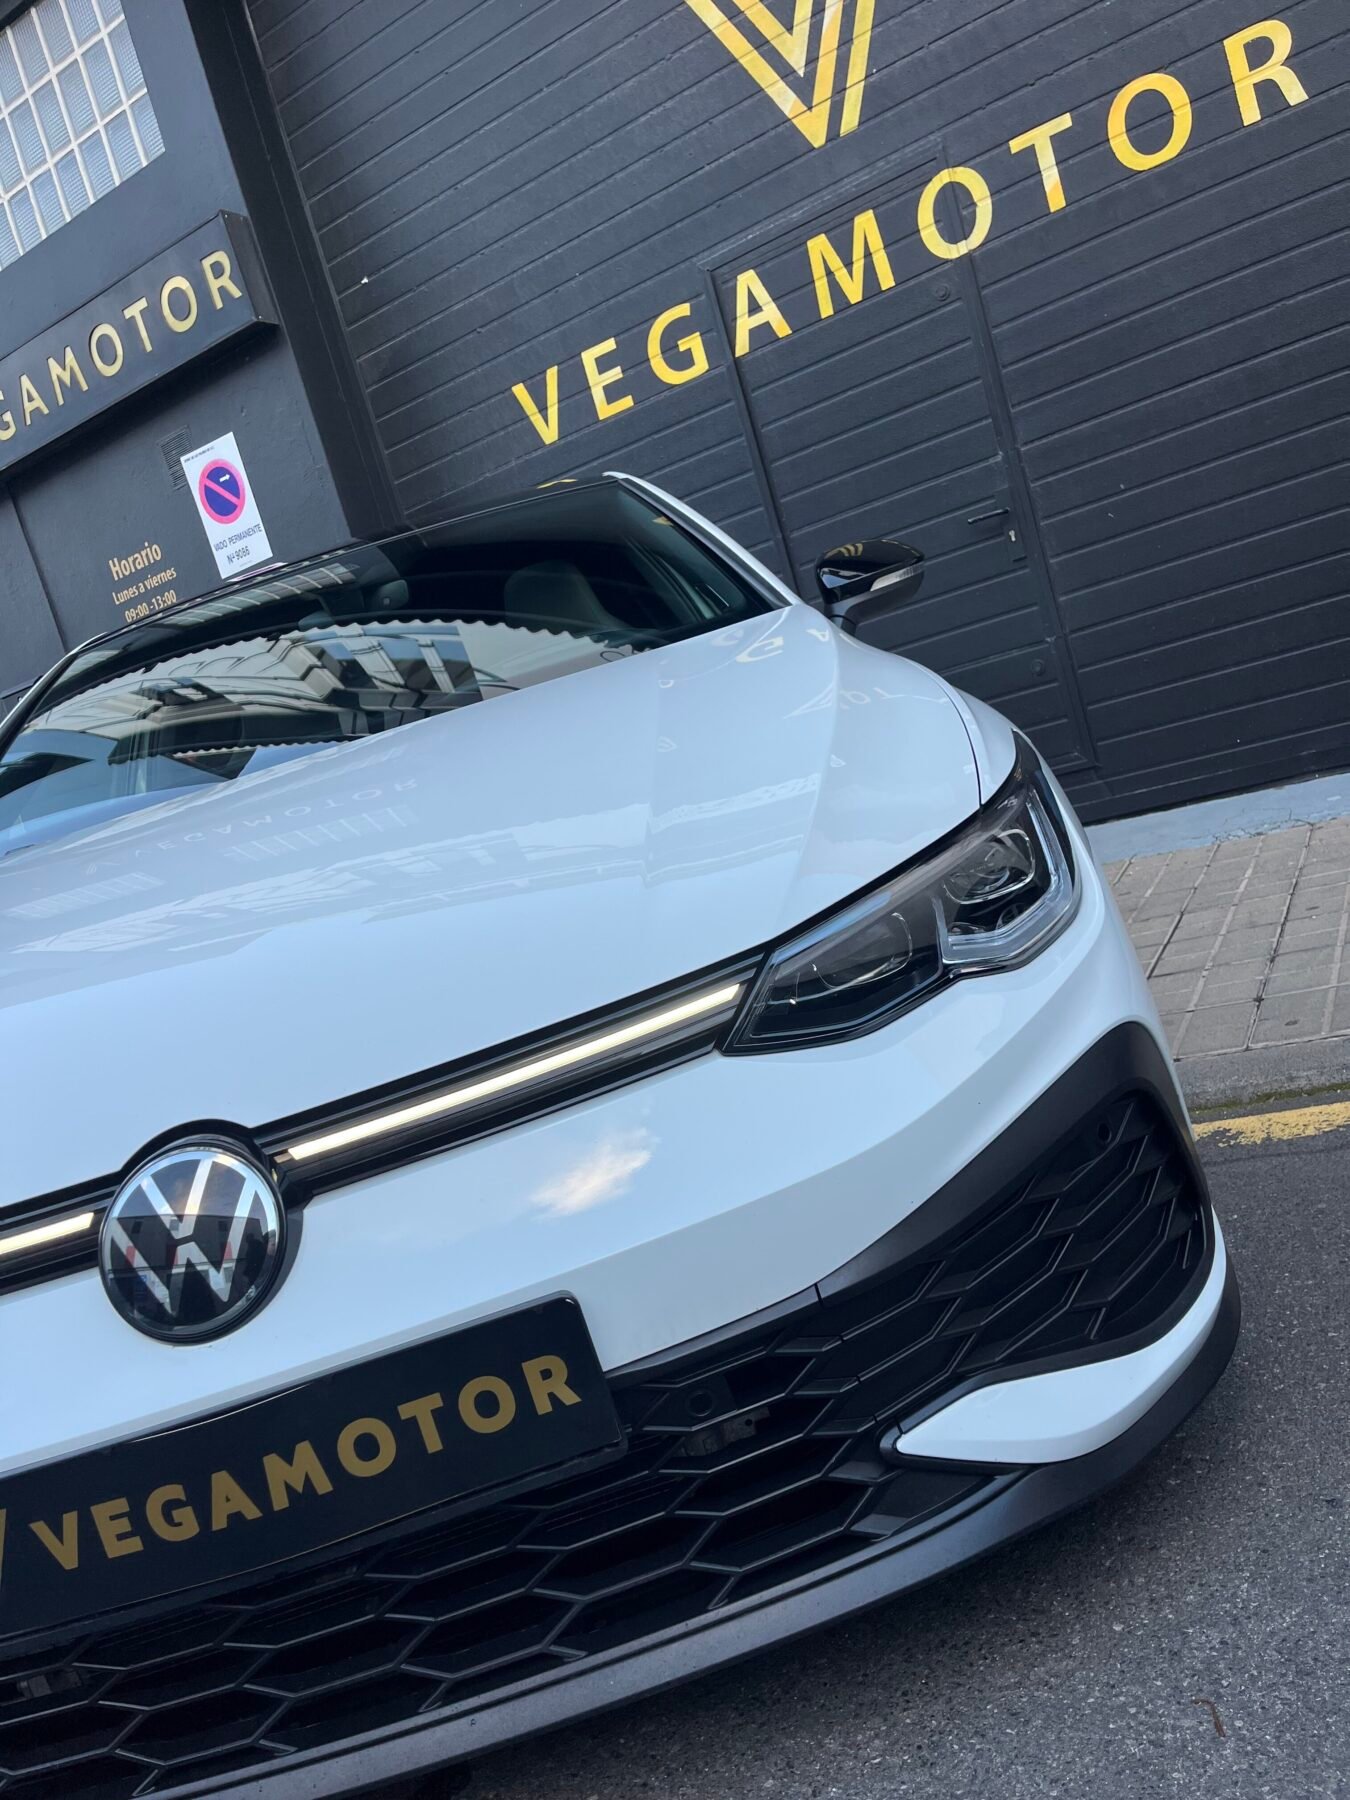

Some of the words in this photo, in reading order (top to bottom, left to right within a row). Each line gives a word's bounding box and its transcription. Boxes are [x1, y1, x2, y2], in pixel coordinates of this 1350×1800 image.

[512, 19, 1309, 445] VEGAMOTOR
[227, 523, 262, 546] PERMANENTE
[108, 541, 162, 581] Horario
[112, 585, 139, 605] Lunes
[138, 582, 145, 593] a
[144, 567, 177, 590] viernes
[125, 602, 149, 623] 09:00
[29, 1354, 582, 1571] VEGAMOTOR
